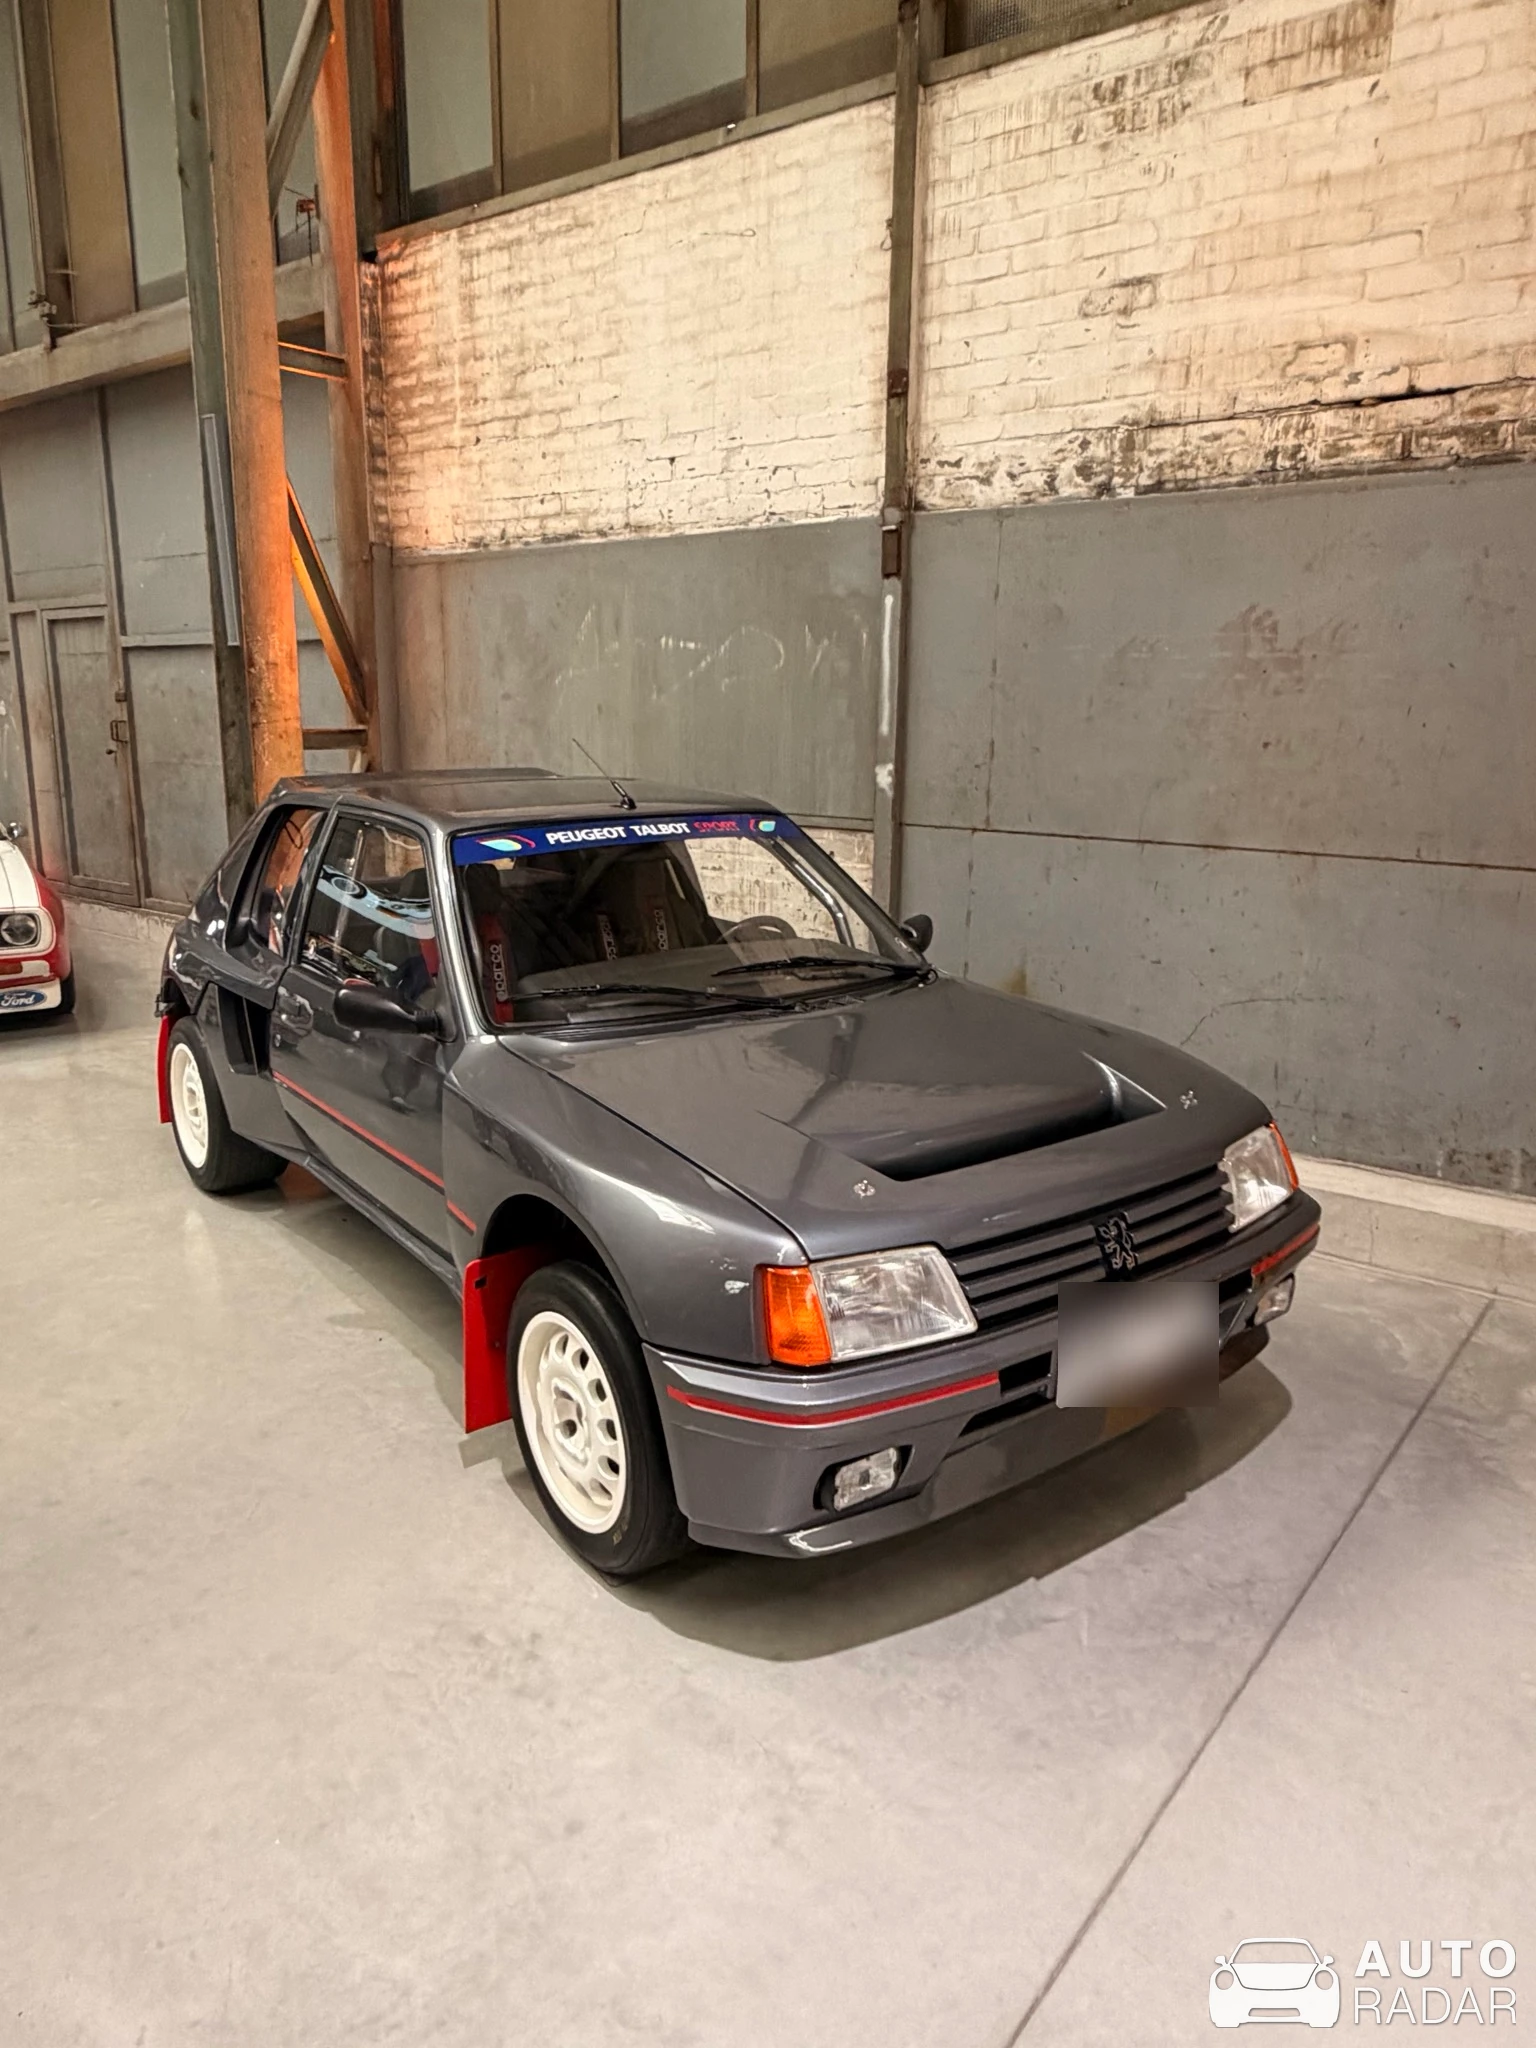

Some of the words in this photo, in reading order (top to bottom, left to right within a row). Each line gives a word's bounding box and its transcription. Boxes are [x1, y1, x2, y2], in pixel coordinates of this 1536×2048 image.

[545, 826, 627, 845] PEUGEOT
[629, 822, 691, 836] TALBOT
[1, 992, 36, 1006] Ford
